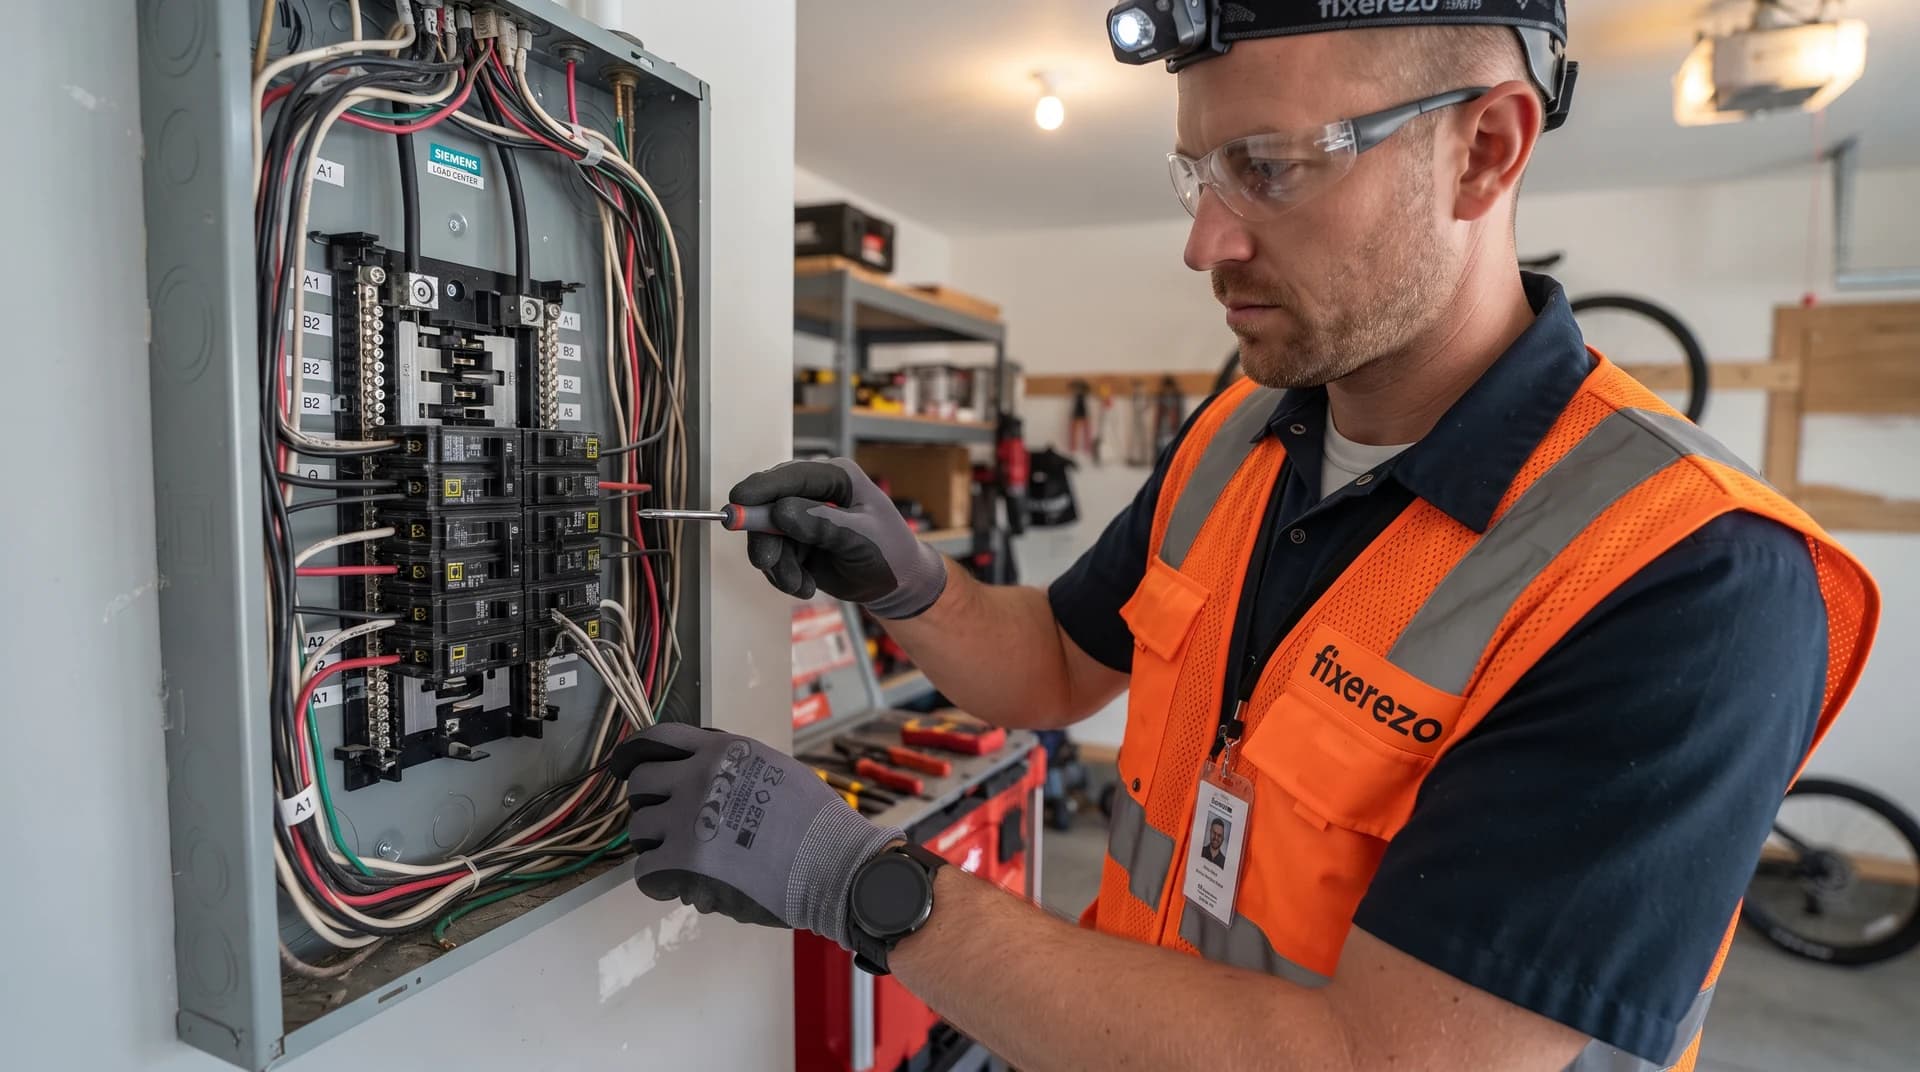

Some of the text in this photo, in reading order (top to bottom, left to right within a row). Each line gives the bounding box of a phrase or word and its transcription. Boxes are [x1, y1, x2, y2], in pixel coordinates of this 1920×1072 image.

[434, 148, 478, 170] SIEMENS
[316, 163, 332, 178] A1
[432, 165, 478, 185] LOAD CENTER
[303, 275, 319, 287] A1
[303, 315, 320, 330] B2
[563, 315, 573, 327] A1
[563, 346, 574, 357] B2
[303, 363, 320, 375] B2
[563, 379, 573, 389] B2
[303, 397, 320, 409] B2
[308, 636, 325, 648] A2
[312, 692, 328, 704] A1
[1309, 644, 1443, 743] fixerezo
[295, 796, 312, 816] A1
